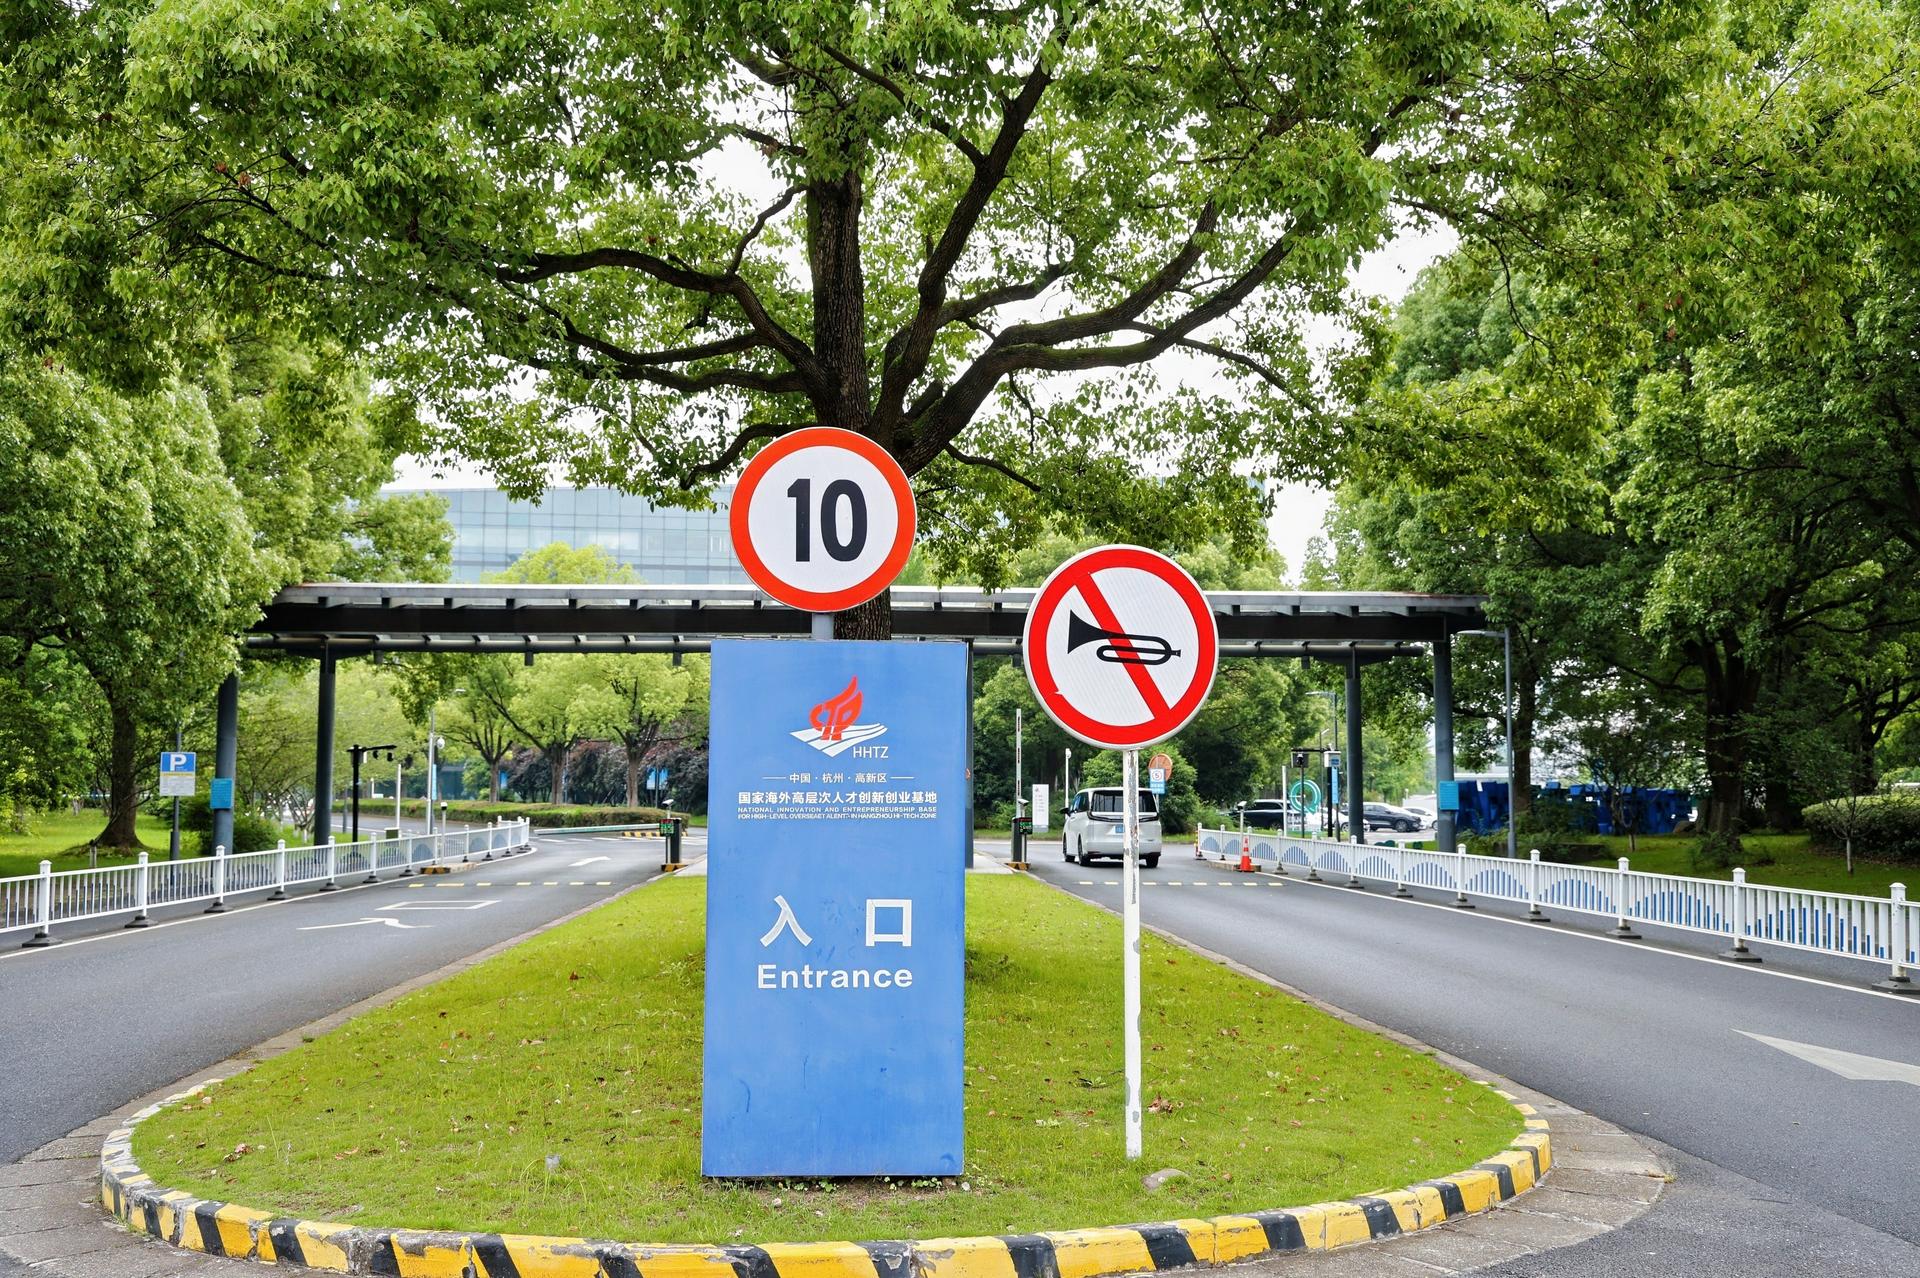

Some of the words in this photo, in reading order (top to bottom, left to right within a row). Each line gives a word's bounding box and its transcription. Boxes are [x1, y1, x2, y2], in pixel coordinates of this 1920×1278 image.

[787, 479, 867, 562] 10
[853, 746, 888, 758] HHTZ
[169, 754, 187, 771] P
[738, 792, 937, 804] 国家海外高层次人才创新创业基地
[758, 964, 913, 989] Entrance
